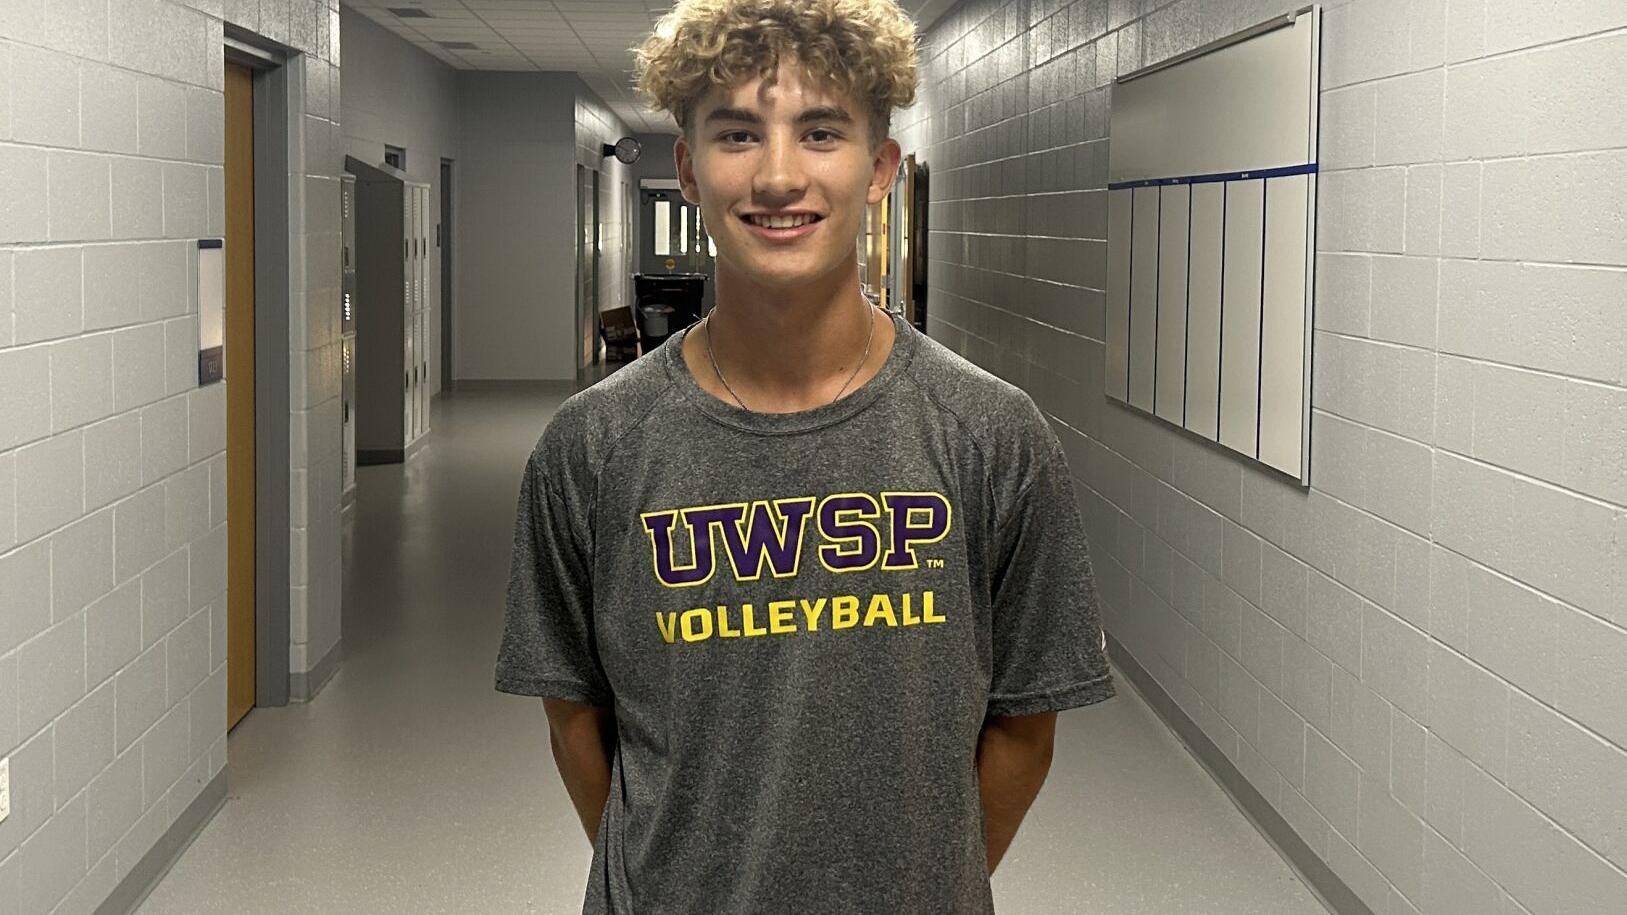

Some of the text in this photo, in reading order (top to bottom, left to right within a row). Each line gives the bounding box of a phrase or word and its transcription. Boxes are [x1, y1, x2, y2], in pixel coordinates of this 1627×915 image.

[640, 491, 951, 588] UWSP
[926, 559, 944, 568] TM
[656, 591, 946, 644] VOLLEYBALL
